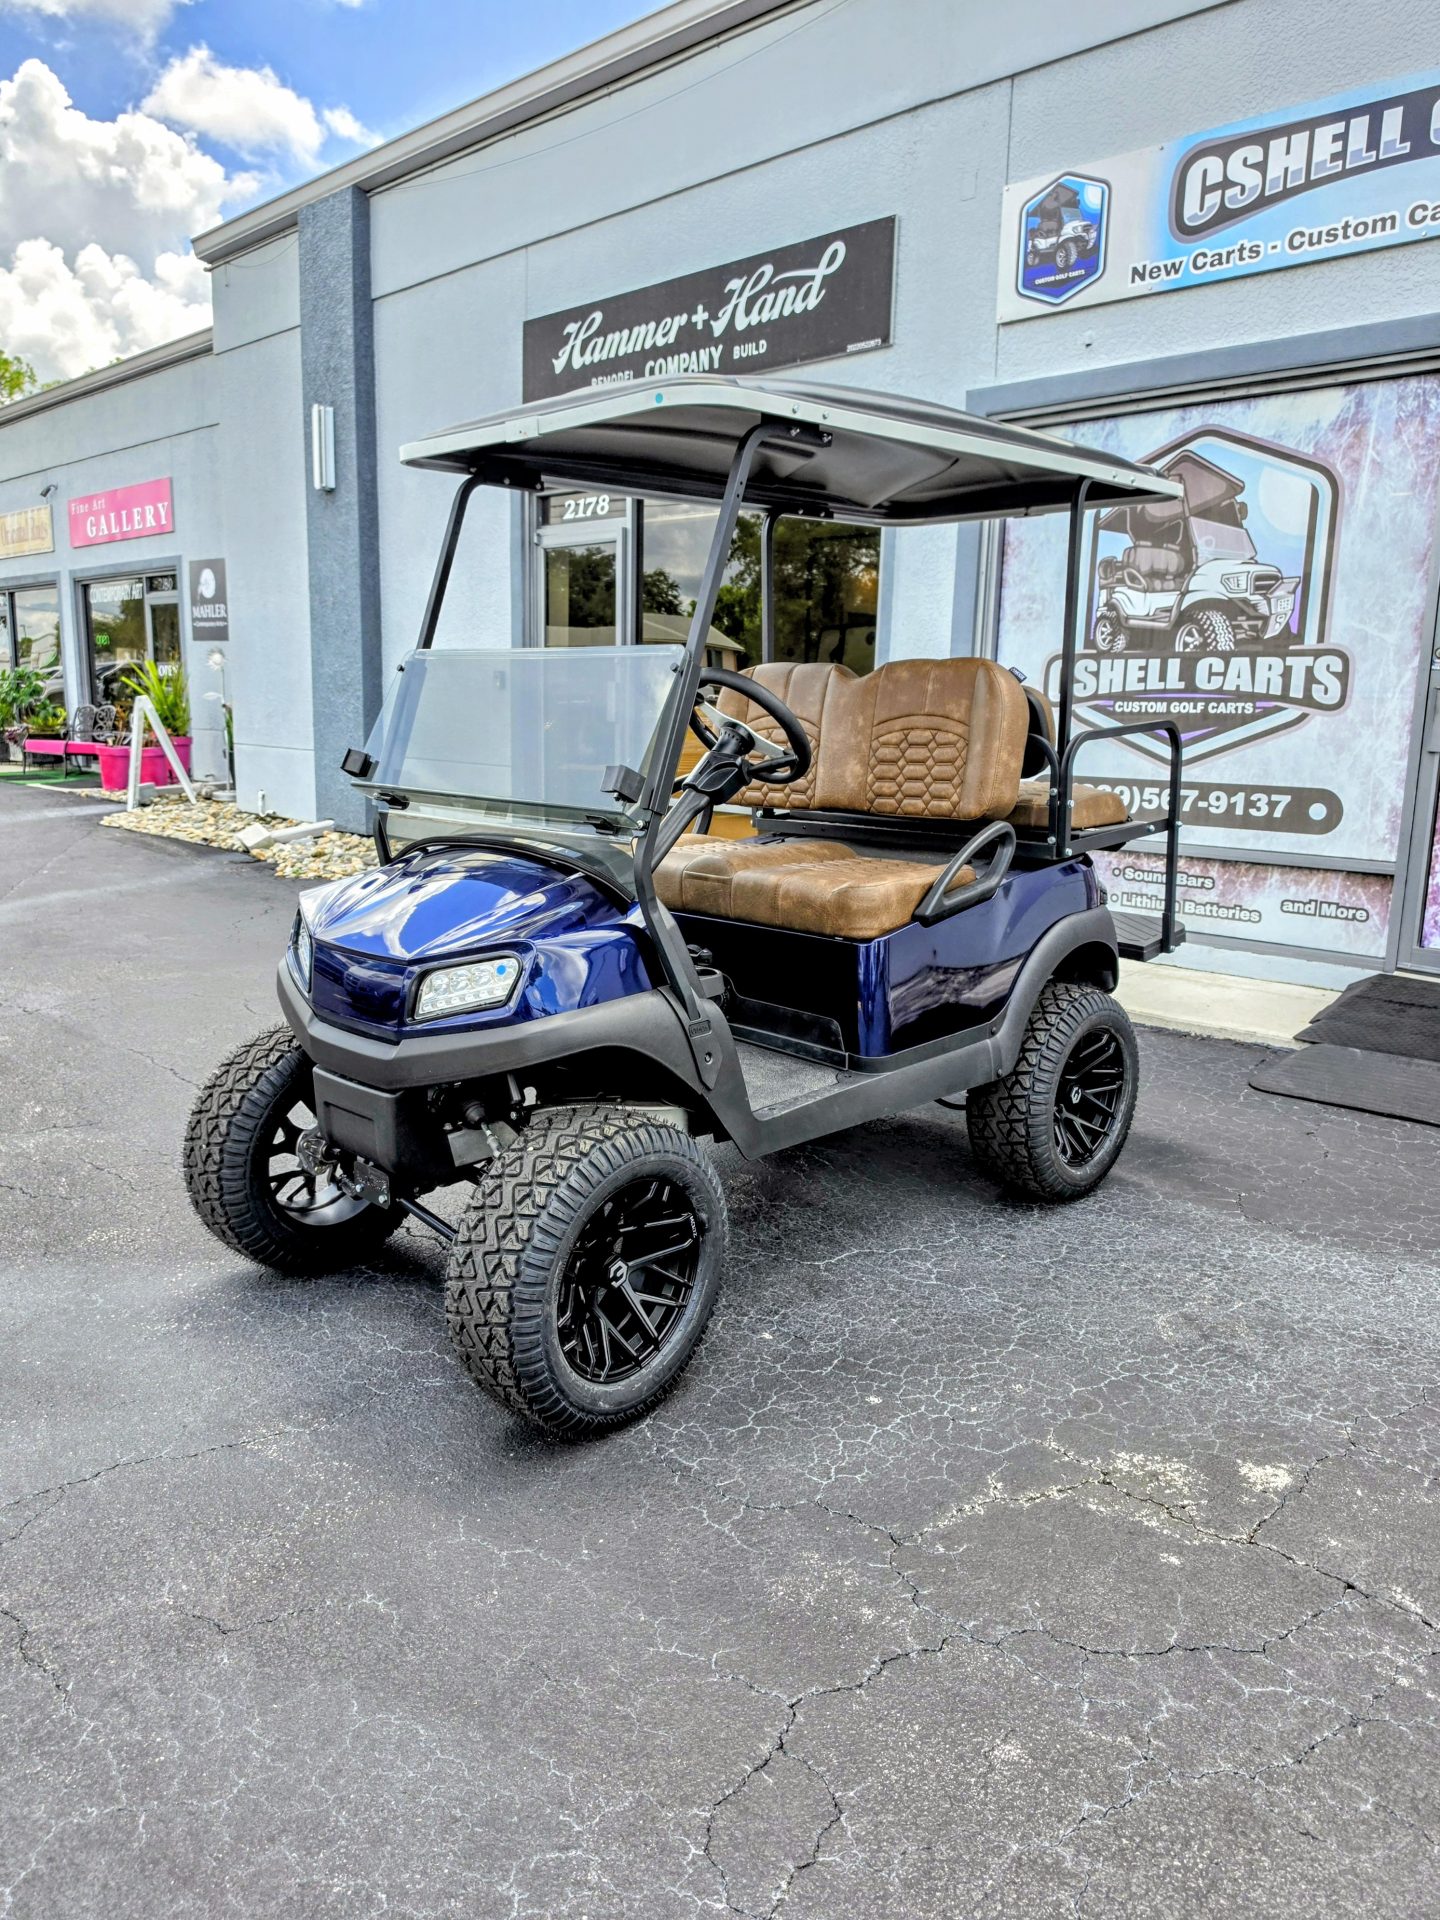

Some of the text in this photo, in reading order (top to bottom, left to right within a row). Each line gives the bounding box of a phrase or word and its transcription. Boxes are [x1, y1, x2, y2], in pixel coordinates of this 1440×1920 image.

[1183, 106, 1411, 227] CSHELL
[1131, 259, 1184, 284] New
[1192, 242, 1261, 272] Carts
[1288, 211, 1397, 251] Custom
[552, 311, 686, 374] Hammer
[710, 241, 847, 338] Hand
[645, 345, 723, 378] COMPANY
[733, 340, 767, 361] BUILD
[71, 499, 106, 515] Fine Art
[87, 502, 169, 538] GALLERY
[564, 494, 610, 520] 2178
[192, 603, 227, 618] MAHLER
[1048, 655, 1343, 705] CSHELL CARTS
[1114, 701, 1254, 714] CUSTOM GOLF CARTS
[1123, 867, 1214, 889] Soun Bars
[1184, 900, 1261, 922] Batteries
[1281, 900, 1369, 922] and More
